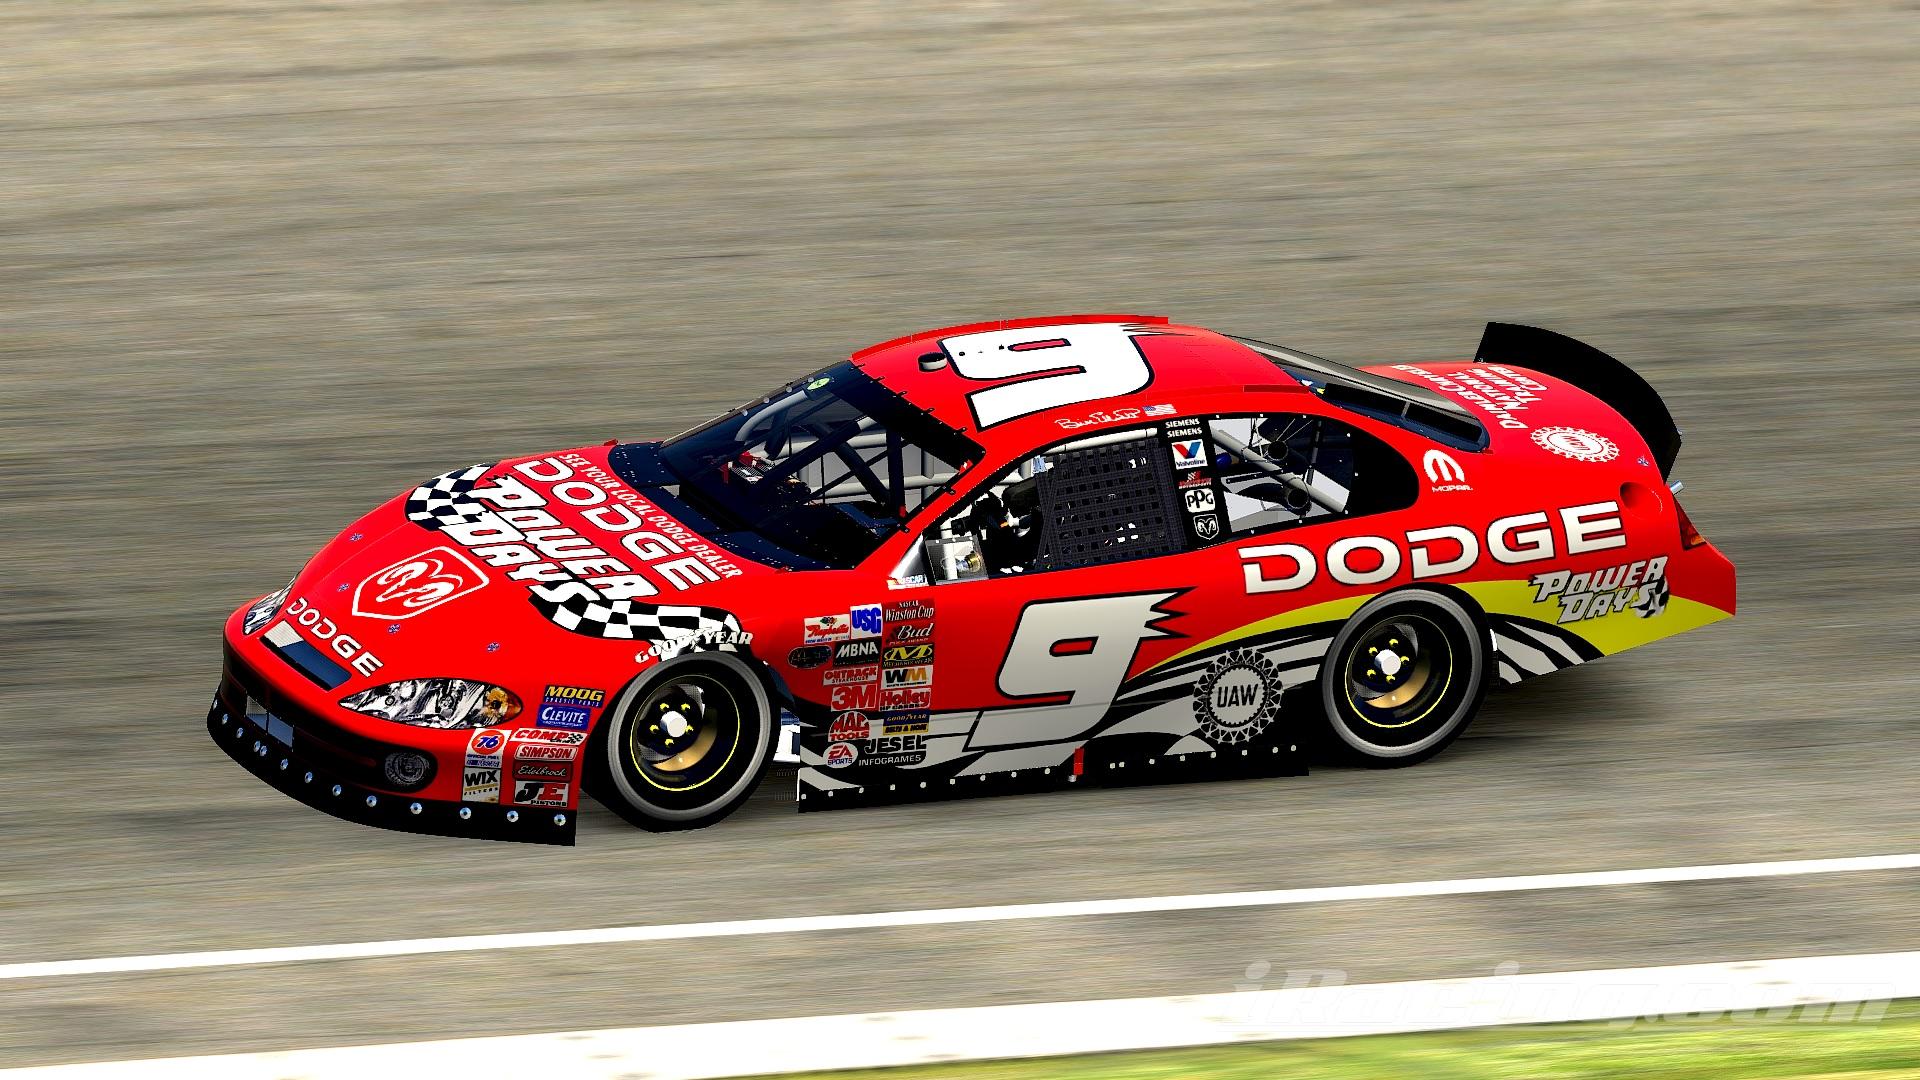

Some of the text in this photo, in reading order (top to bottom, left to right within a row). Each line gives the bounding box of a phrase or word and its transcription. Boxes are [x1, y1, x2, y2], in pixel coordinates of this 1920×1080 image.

[940, 321, 1162, 434] 9
[1165, 418, 1200, 429] SIEMENS
[1167, 427, 1203, 438] SIEMENS
[1175, 459, 1206, 468] Valvoline
[1187, 489, 1214, 509] PPG
[559, 453, 743, 578] SEE YOUR LOCAL DODGE DEALER
[512, 457, 722, 593] DODGE
[472, 474, 661, 601] POWER
[1237, 500, 1627, 595] DODGE
[437, 510, 602, 604] DAYS
[1529, 555, 1668, 603] POWER
[1557, 583, 1660, 624] DAYS
[851, 607, 882, 635] USG
[884, 604, 935, 622] Winston Cup
[285, 597, 385, 678] DODGE
[897, 623, 935, 641] Bud
[634, 627, 754, 663] GOODYEAR
[836, 641, 878, 658] MBNA
[825, 667, 877, 680] OUTBACK
[885, 668, 928, 684] WM
[962, 587, 1192, 751] 9
[545, 686, 603, 702] MOOG
[832, 685, 875, 710] 3M
[880, 690, 931, 708] Holley
[1217, 683, 1258, 708] UAW
[541, 707, 587, 724] CLEVITE
[831, 711, 870, 733] MAC
[886, 713, 927, 723] GOODYEAR
[476, 735, 499, 749] 76
[515, 729, 569, 741] COMP
[829, 730, 871, 741] TOOLS
[520, 746, 573, 759] SIMPSON
[828, 745, 853, 759] EA
[864, 735, 928, 755] JESEL
[827, 757, 853, 766] SPORTS
[858, 755, 922, 767] INFOGRAMES
[464, 770, 498, 787] WIX
[517, 765, 567, 777] Edelbrock
[463, 787, 498, 796] FILTERS
[515, 782, 568, 802] JE
